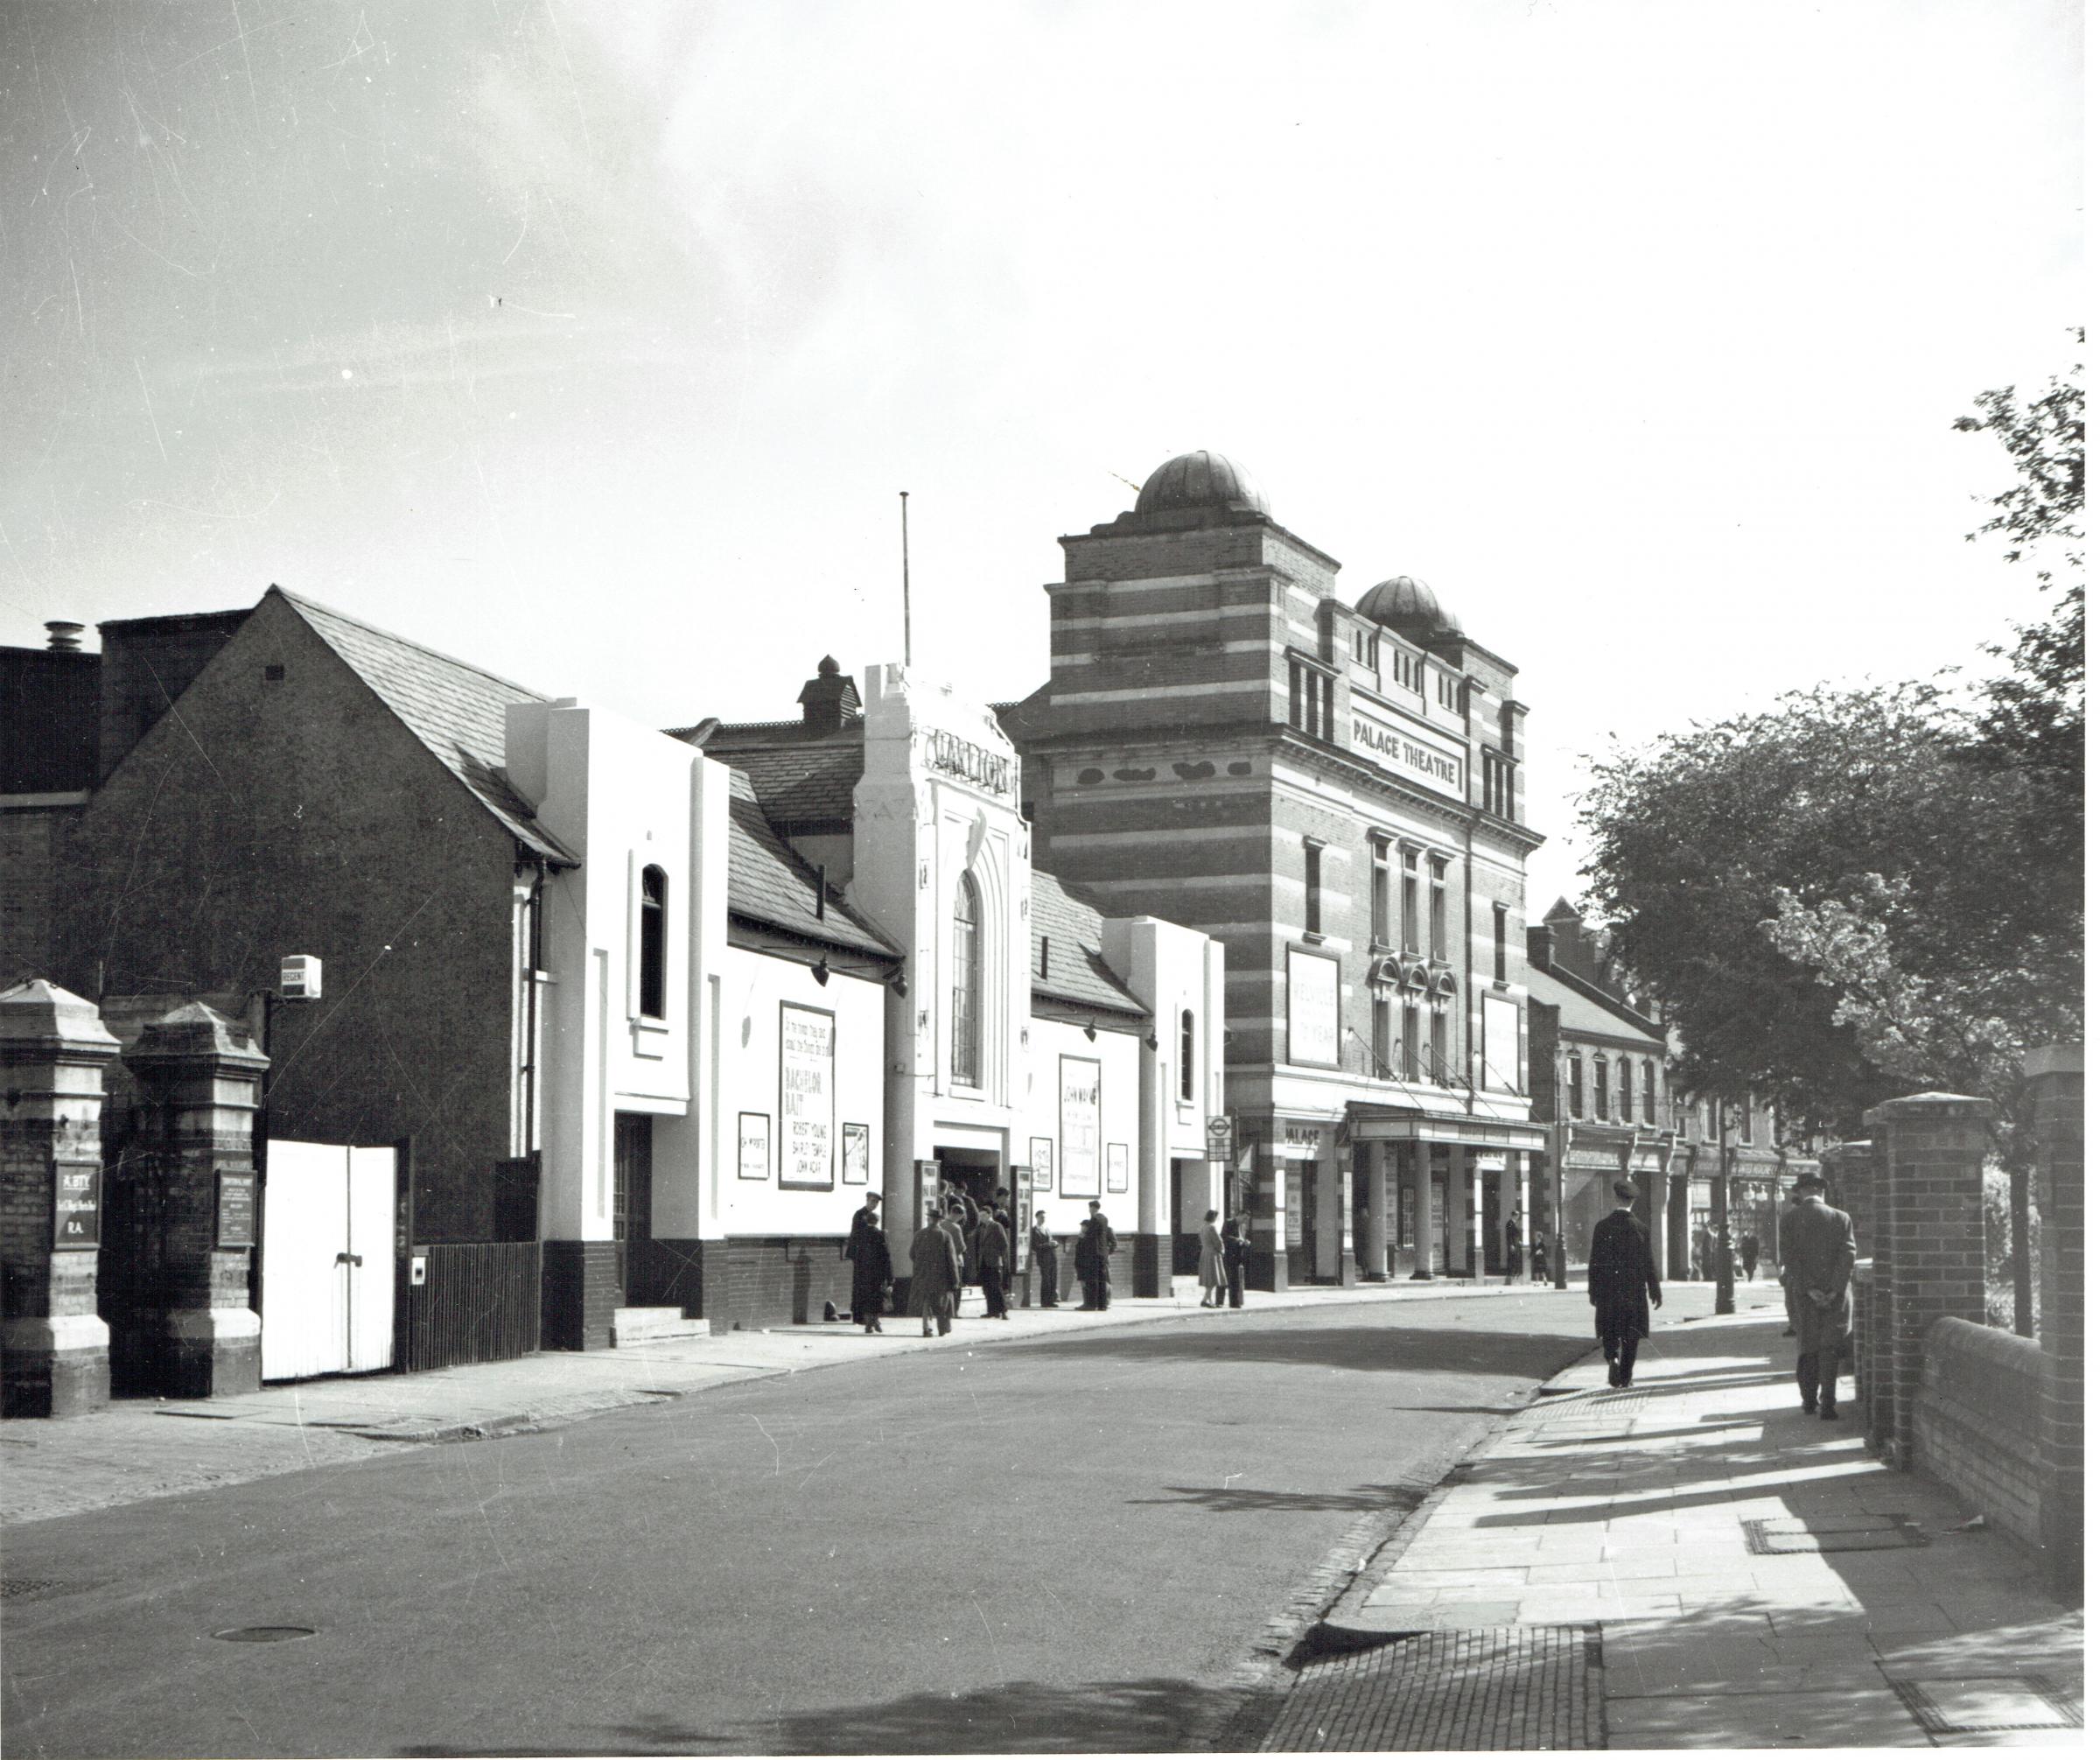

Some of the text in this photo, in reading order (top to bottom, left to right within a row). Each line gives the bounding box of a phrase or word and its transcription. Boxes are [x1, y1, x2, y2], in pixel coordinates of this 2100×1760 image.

[1354, 719, 1455, 784] PALACE THEATRE
[282, 971, 305, 982] REGENT
[785, 1066, 822, 1095] BACHELOR
[785, 1091, 804, 1117] BAIT
